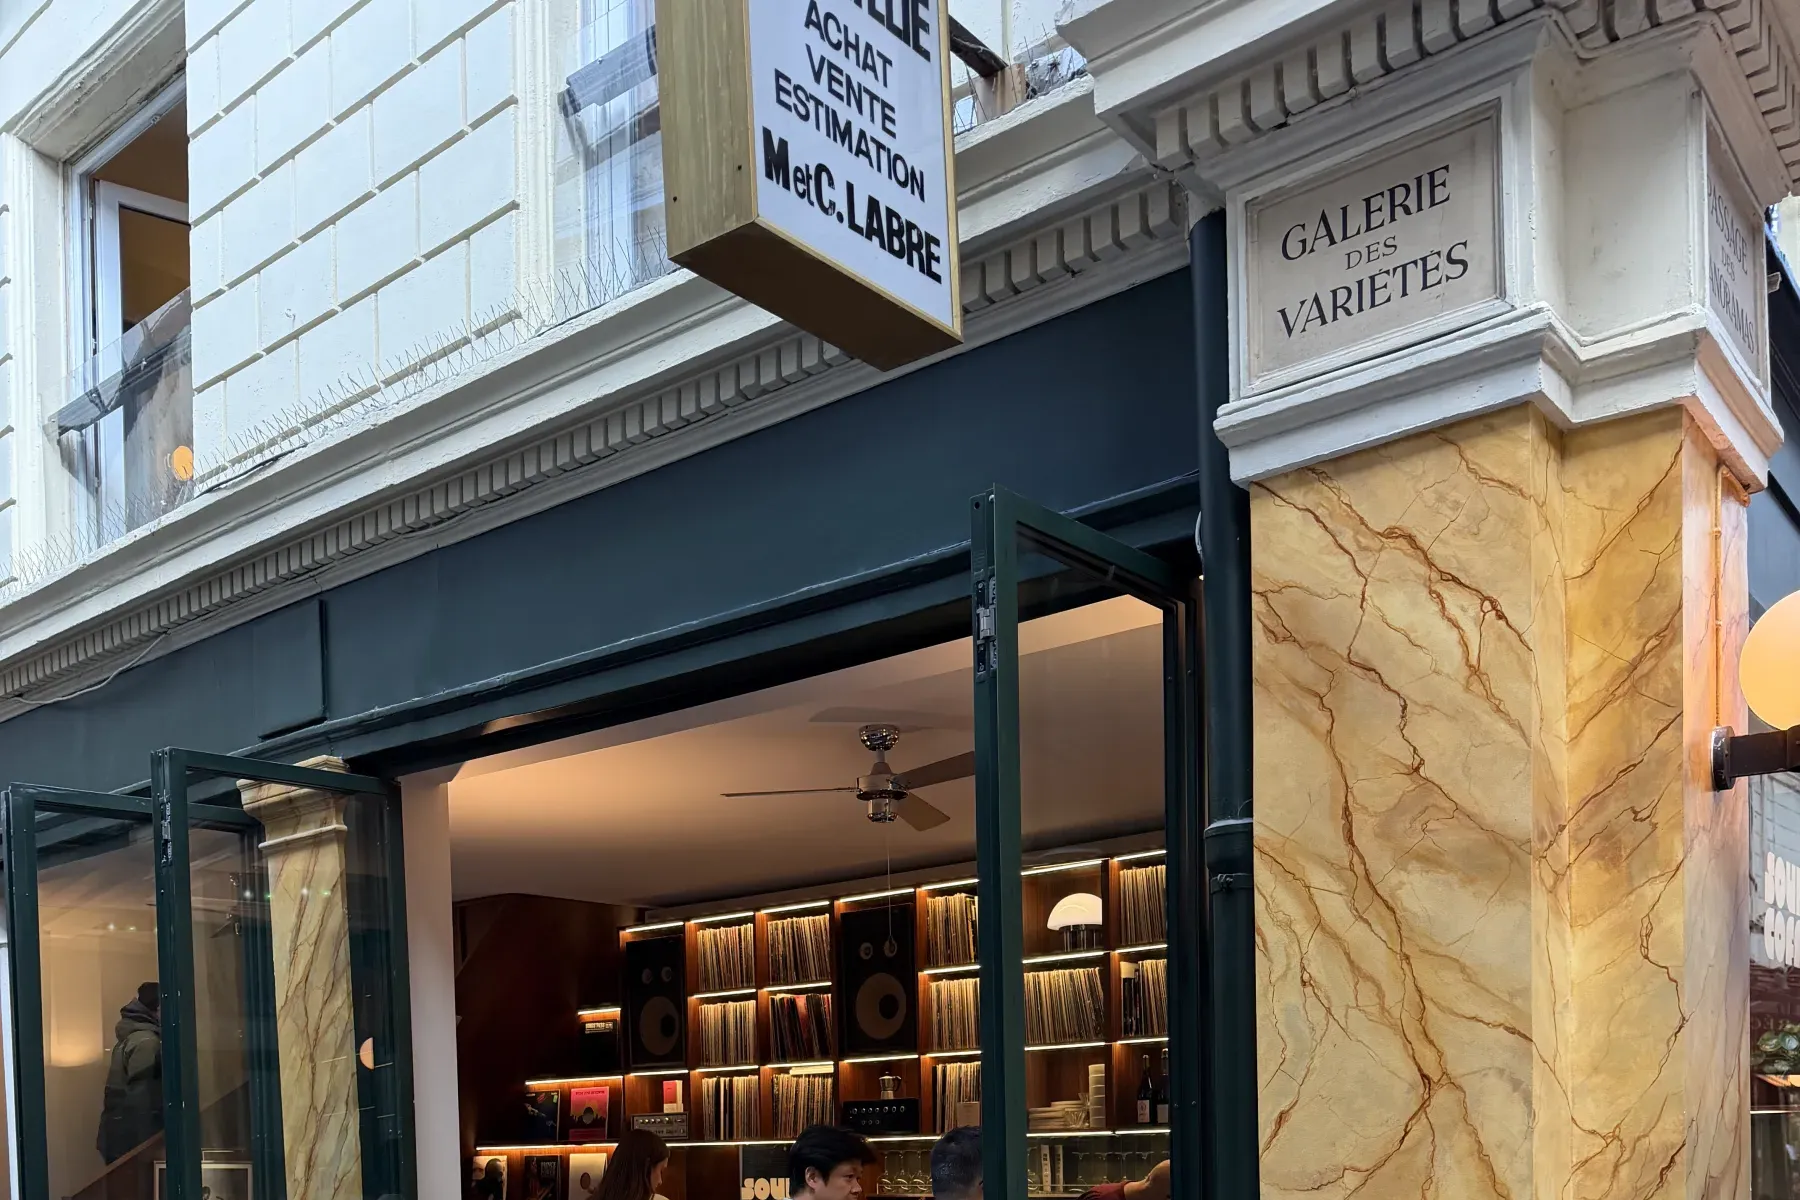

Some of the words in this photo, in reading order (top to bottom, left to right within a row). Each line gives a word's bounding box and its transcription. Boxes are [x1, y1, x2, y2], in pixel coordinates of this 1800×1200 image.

[804, 0, 893, 88] ACHAT
[805, 43, 897, 139] VENTE
[774, 68, 925, 203] ESTIMATION
[1281, 164, 1450, 261] GALERIE
[1345, 235, 1398, 270] DES
[1277, 240, 1469, 339] VARIÉTÉS
[1708, 252, 1754, 354] ANORAMAS
[1721, 244, 1735, 282] DES
